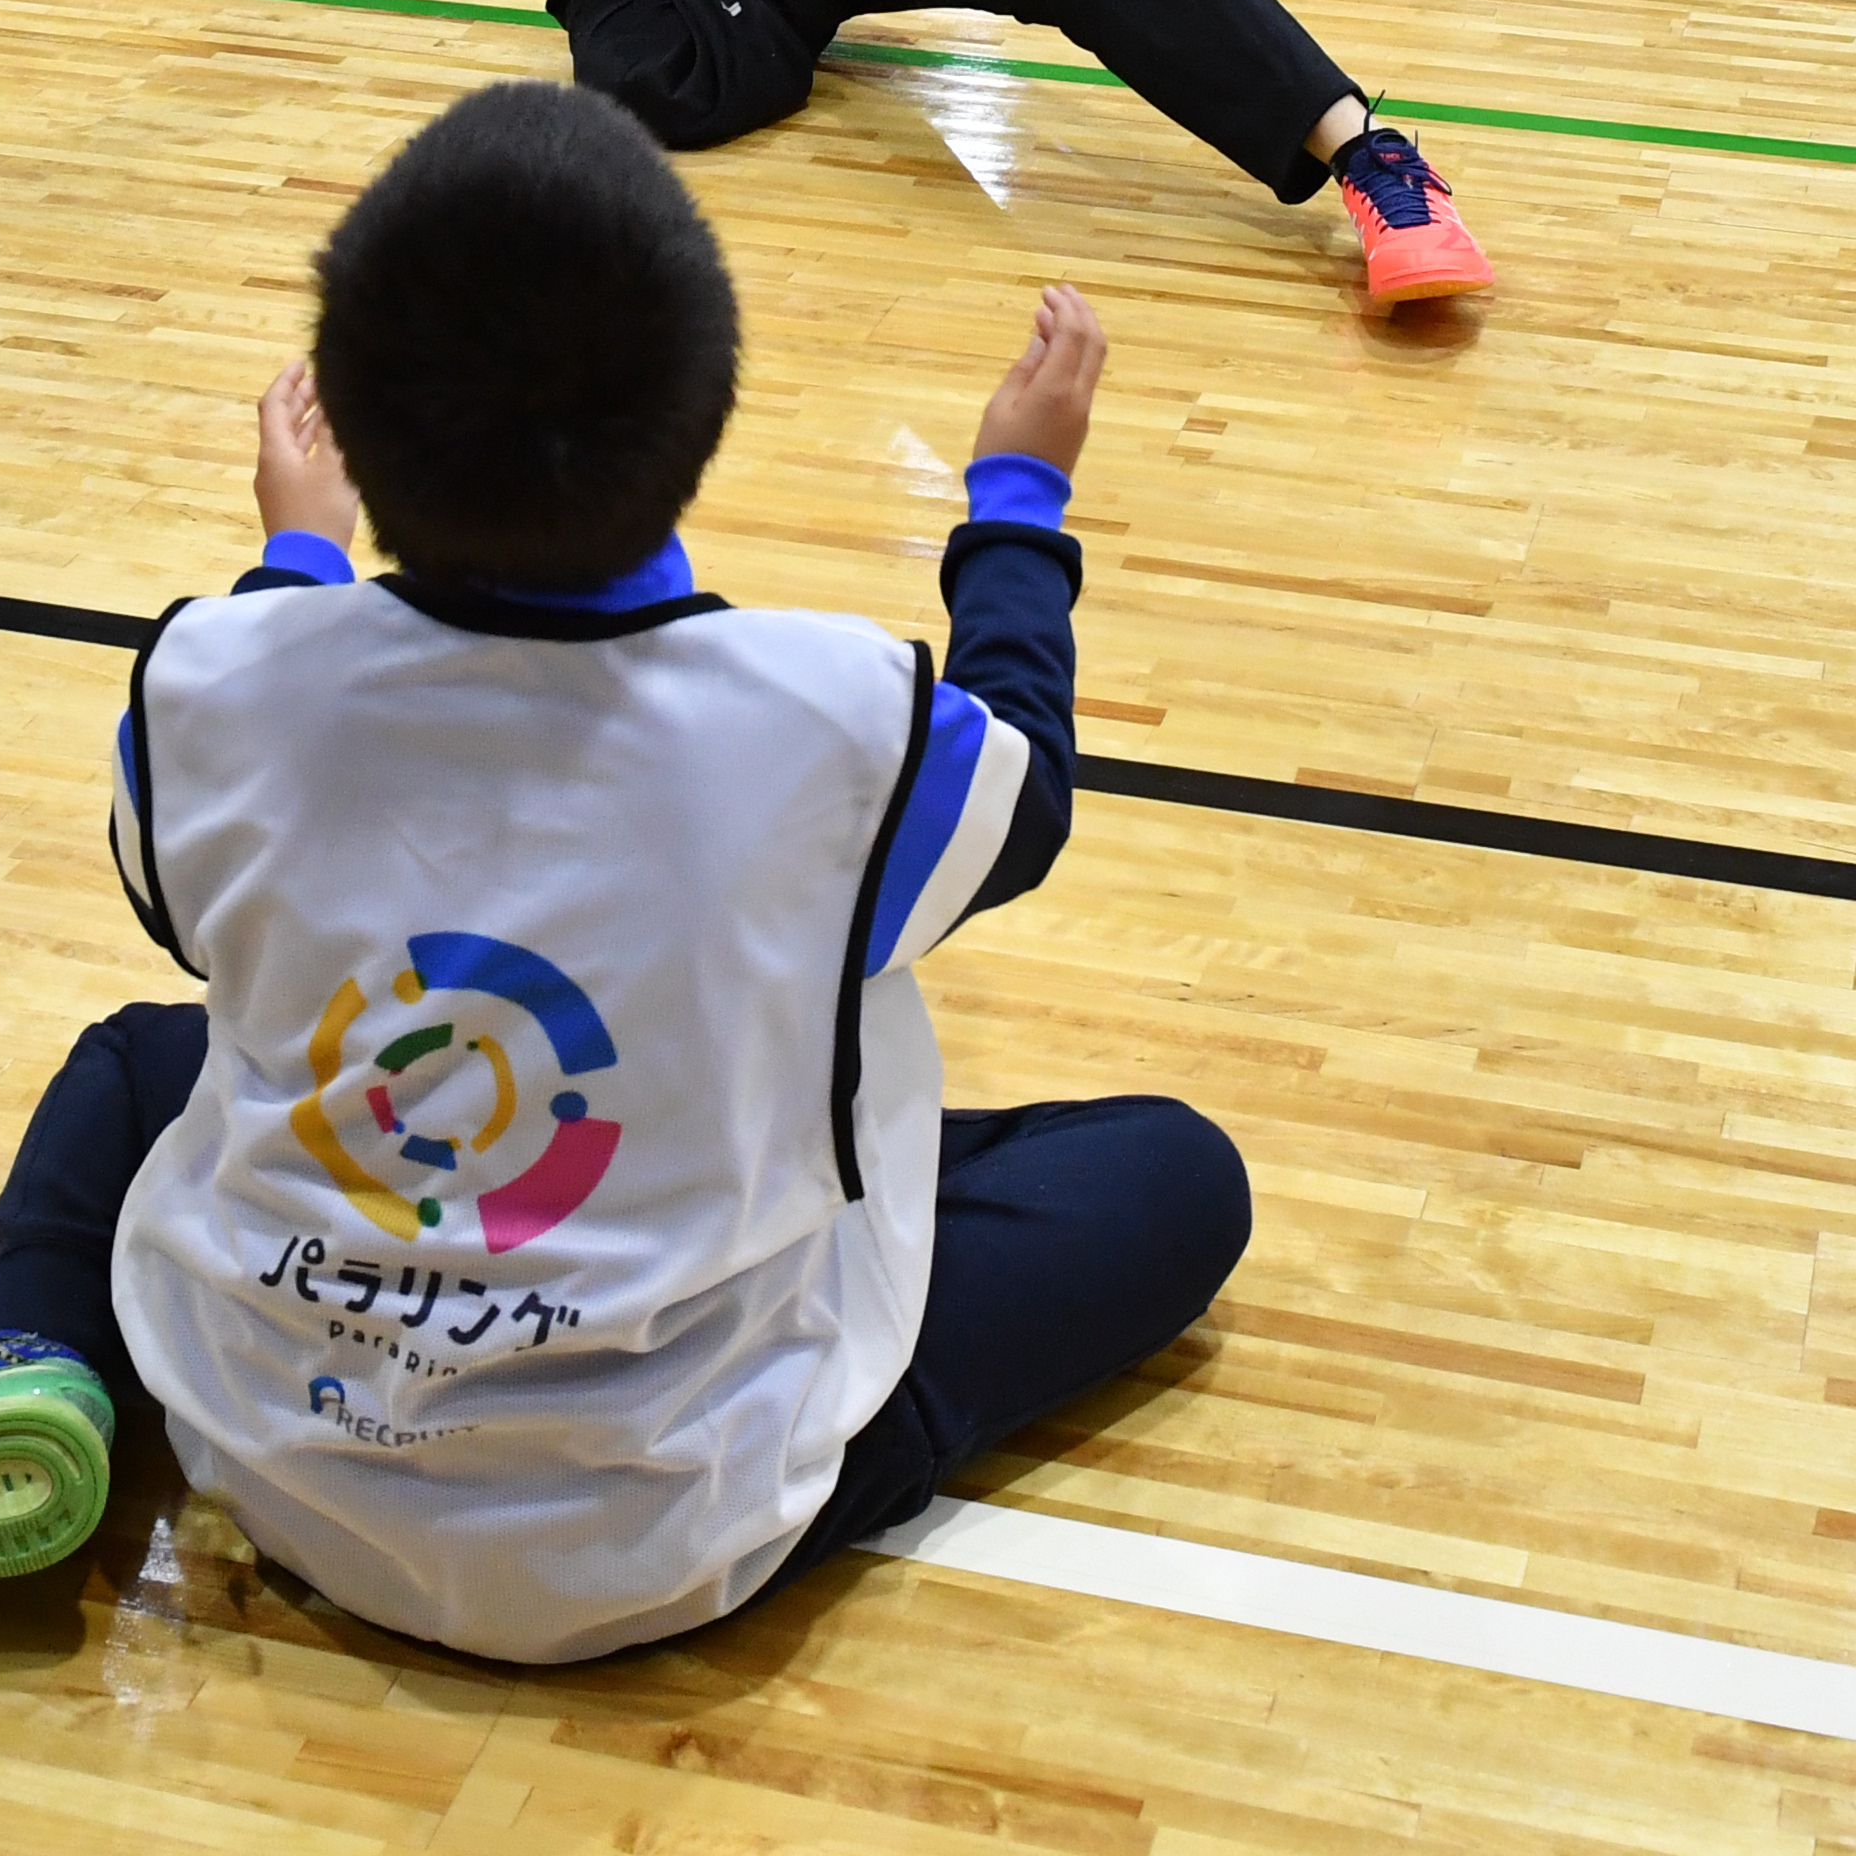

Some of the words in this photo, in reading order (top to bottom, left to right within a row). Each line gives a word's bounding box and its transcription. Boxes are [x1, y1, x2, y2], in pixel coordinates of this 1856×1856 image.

[259, 1235, 580, 1352] パラリング
[336, 1405, 481, 1447] RECR
